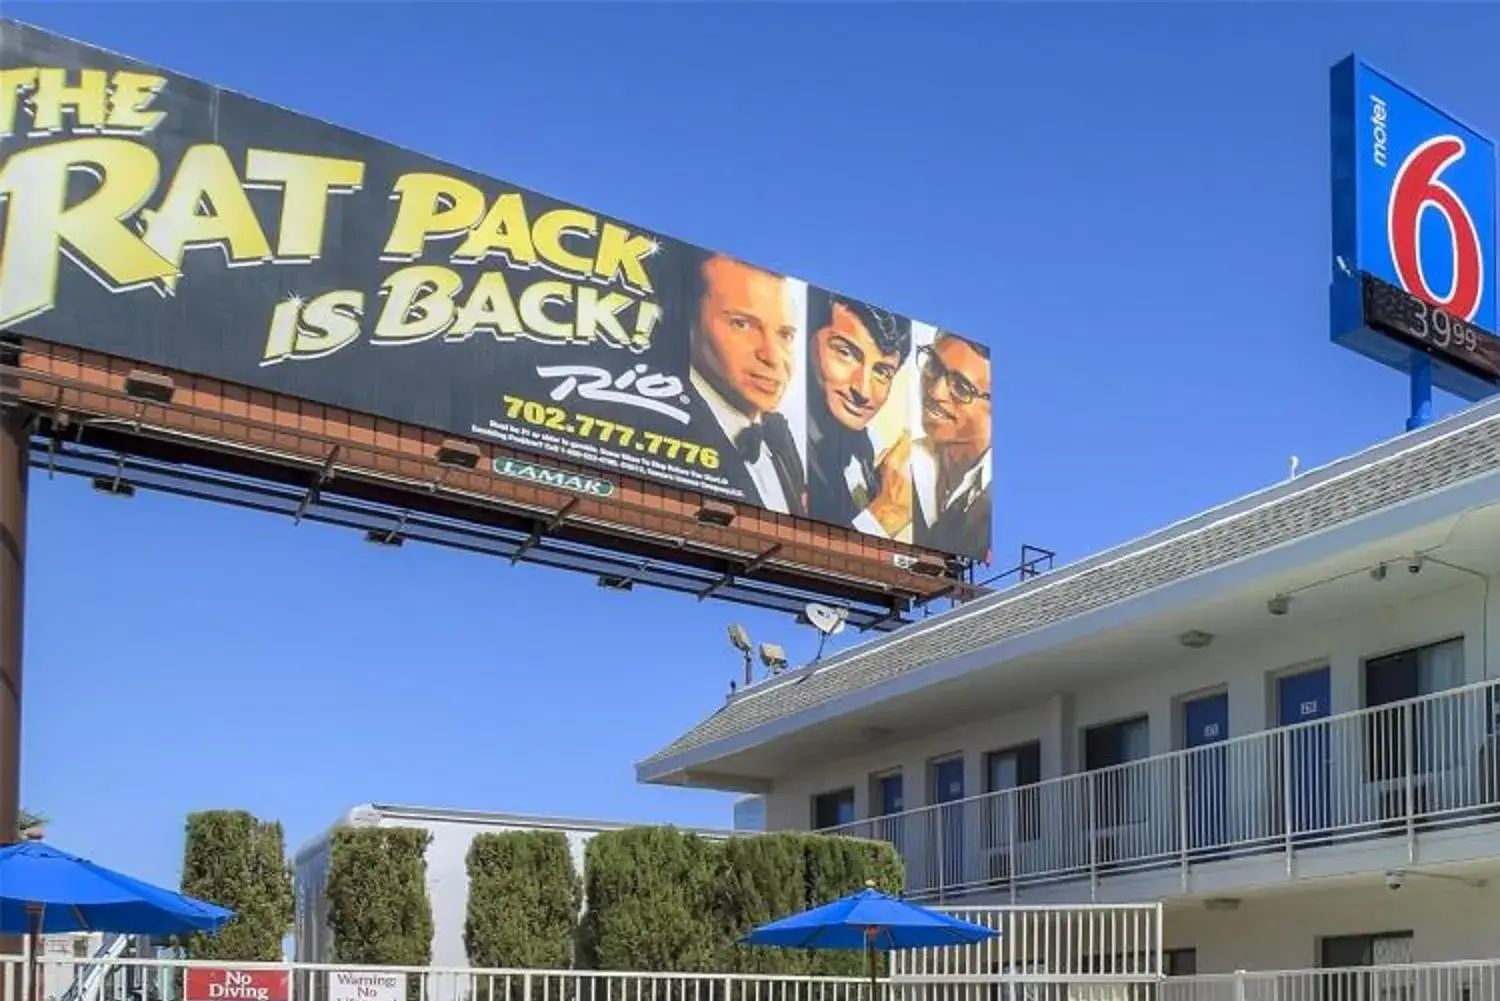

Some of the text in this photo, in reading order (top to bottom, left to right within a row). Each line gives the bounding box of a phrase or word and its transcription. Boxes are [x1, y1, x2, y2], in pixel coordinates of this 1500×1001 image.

[1369, 94, 1387, 167] motel
[0, 136, 658, 330] RAT PACK
[1387, 134, 1483, 324] 6
[261, 265, 662, 365] IS BACK!
[503, 395, 720, 470] 702.777.7776
[209, 983, 269, 1000] Diving
[225, 971, 253, 985] No
[357, 987, 377, 997] No
